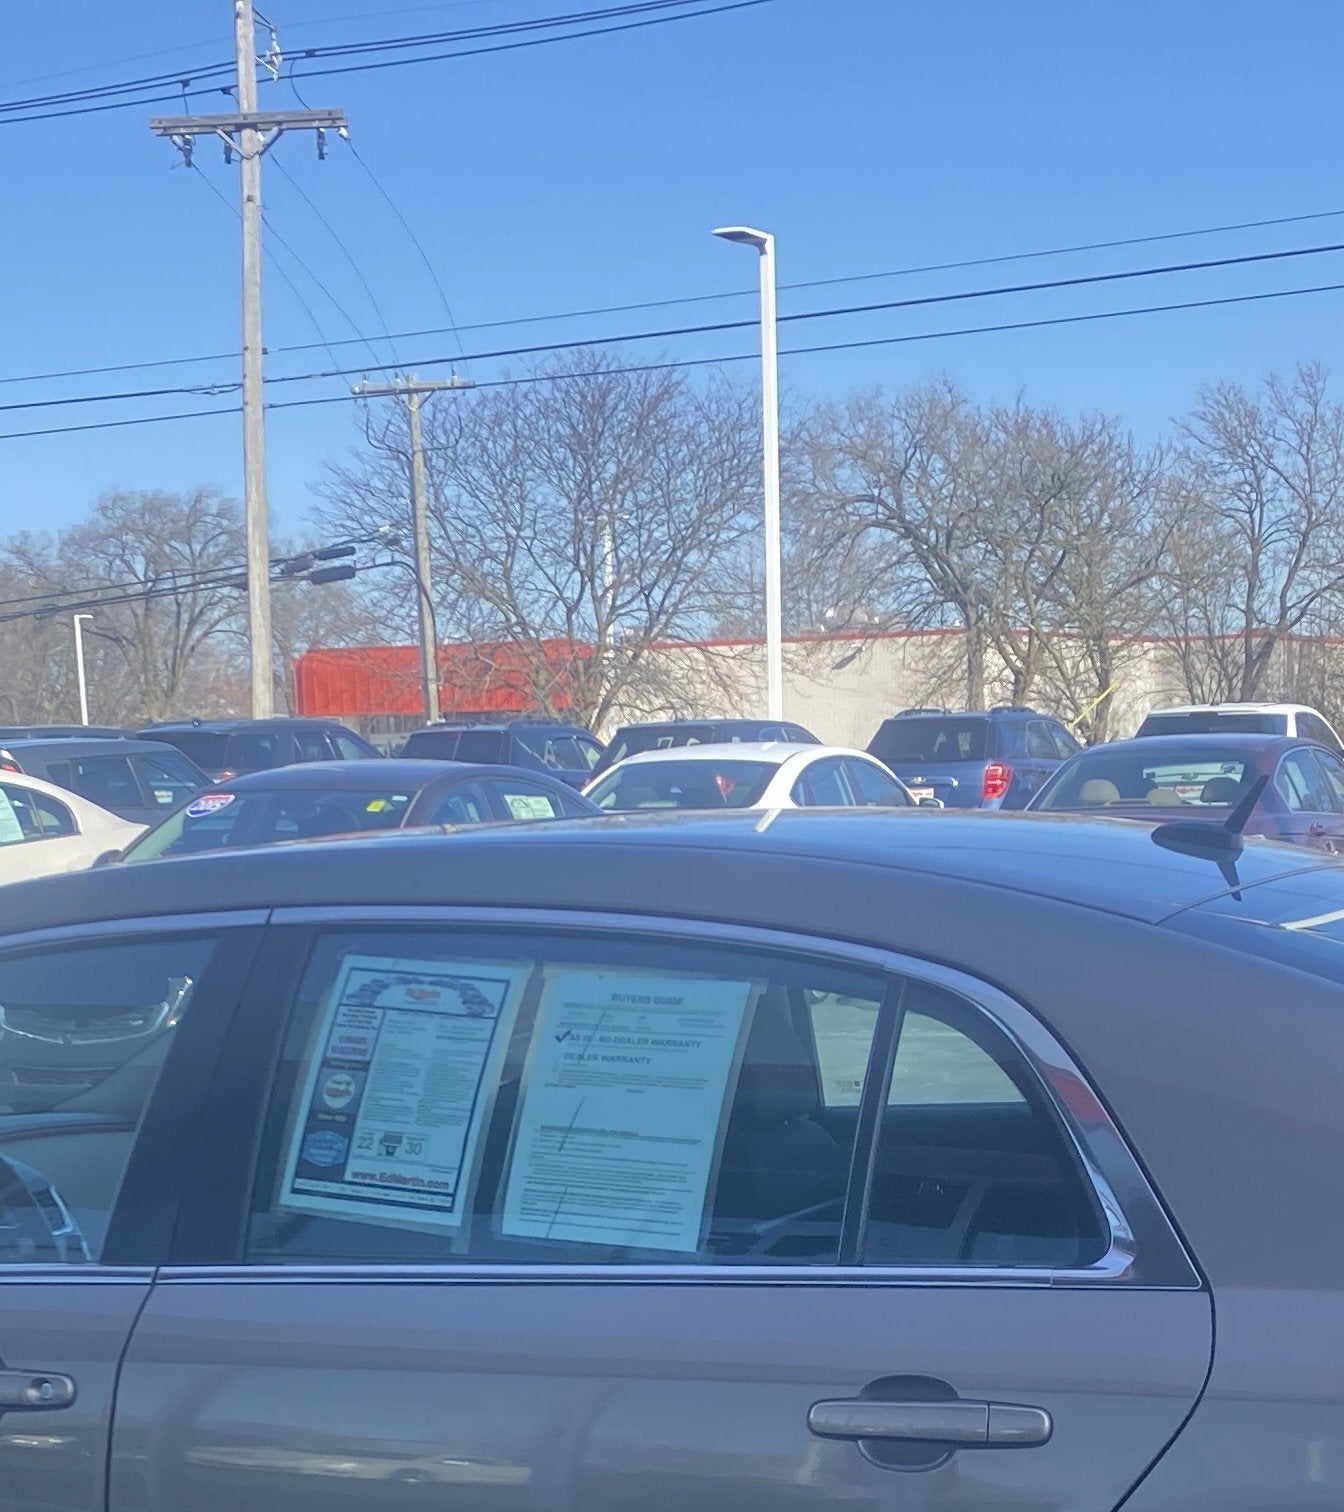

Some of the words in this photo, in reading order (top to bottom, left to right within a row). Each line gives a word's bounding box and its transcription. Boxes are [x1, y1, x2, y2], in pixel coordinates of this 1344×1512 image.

[613, 1036, 650, 1047] DEALER
[651, 1038, 703, 1049] WARRANTY
[600, 1055, 652, 1066] WARRANTY
[357, 1135, 375, 1151] 22
[404, 1140, 423, 1156] 30
